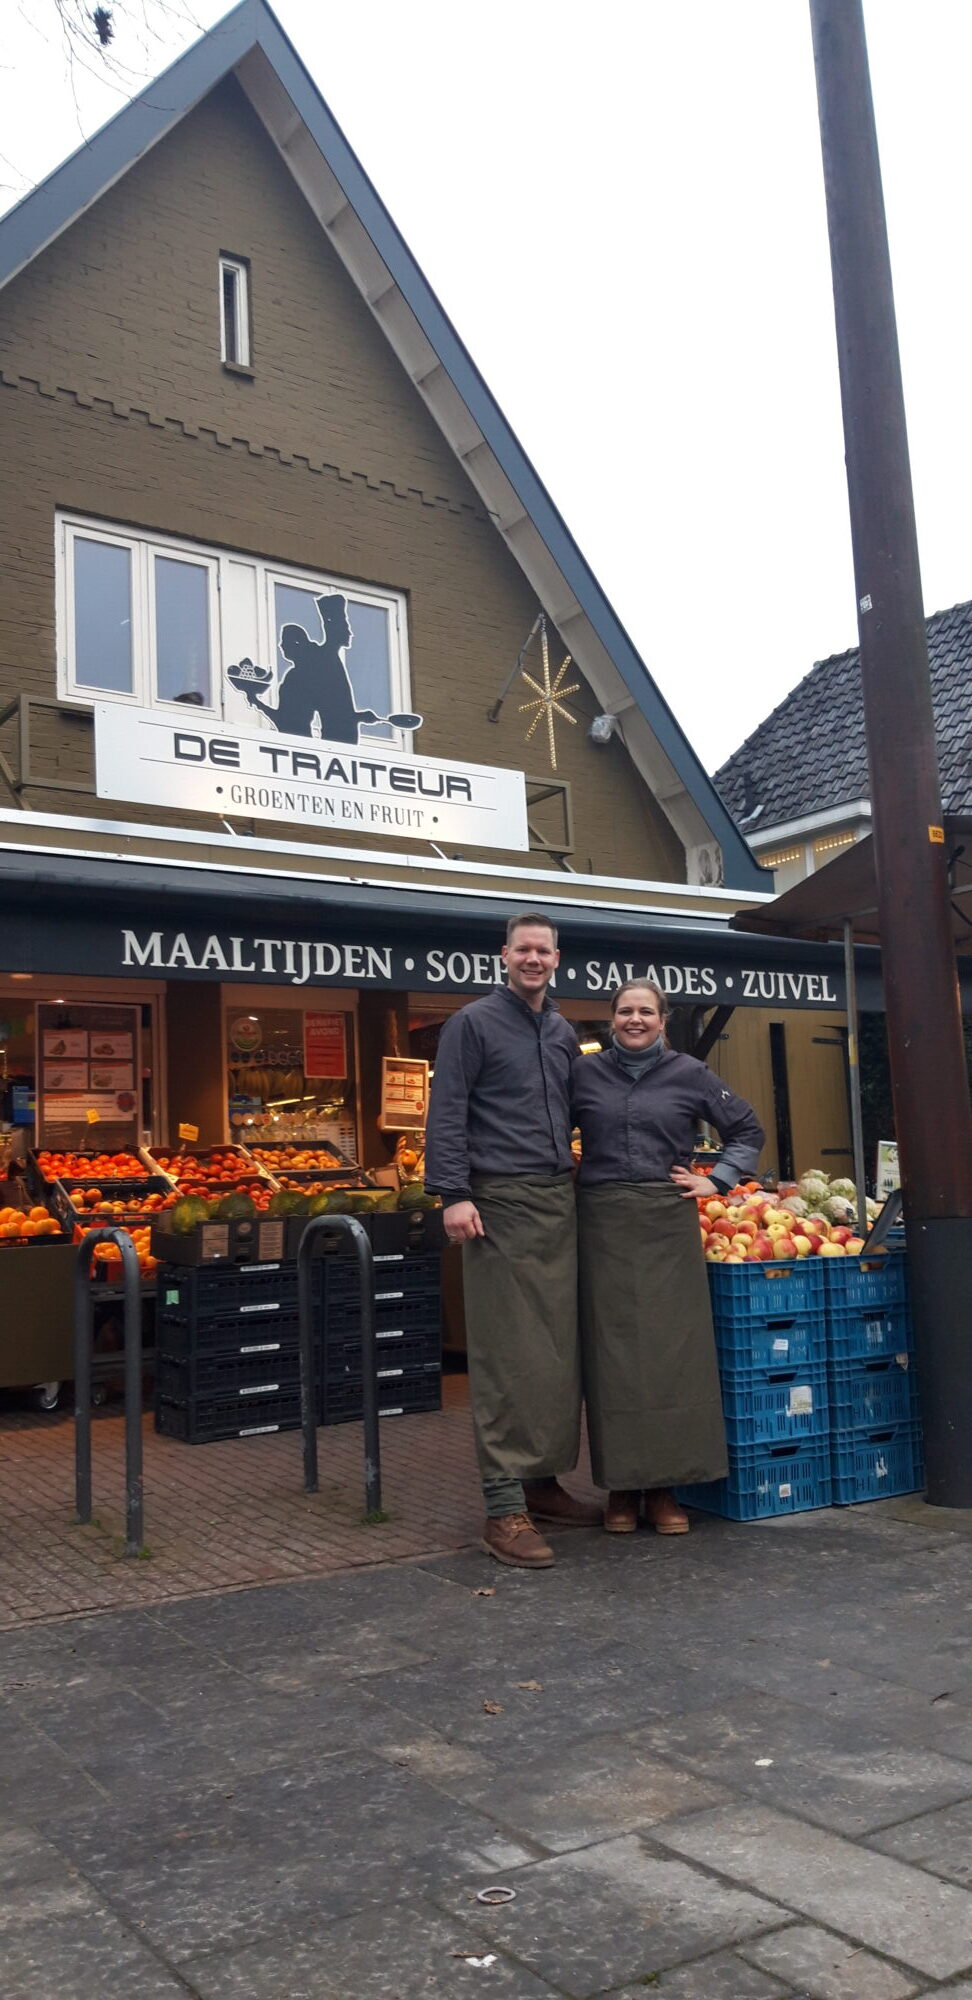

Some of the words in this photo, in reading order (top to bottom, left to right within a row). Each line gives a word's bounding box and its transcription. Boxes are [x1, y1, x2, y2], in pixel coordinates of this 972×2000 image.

[174, 732, 241, 768] DE
[259, 746, 472, 801] TRAITEUR
[230, 784, 336, 816] GROENTEN
[341, 800, 364, 820] EN
[370, 805, 424, 828] FRUIT
[121, 929, 393, 985] MAALTIJDEN
[425, 950, 557, 988] SOEP
[740, 970, 837, 1003] ZUIVEL
